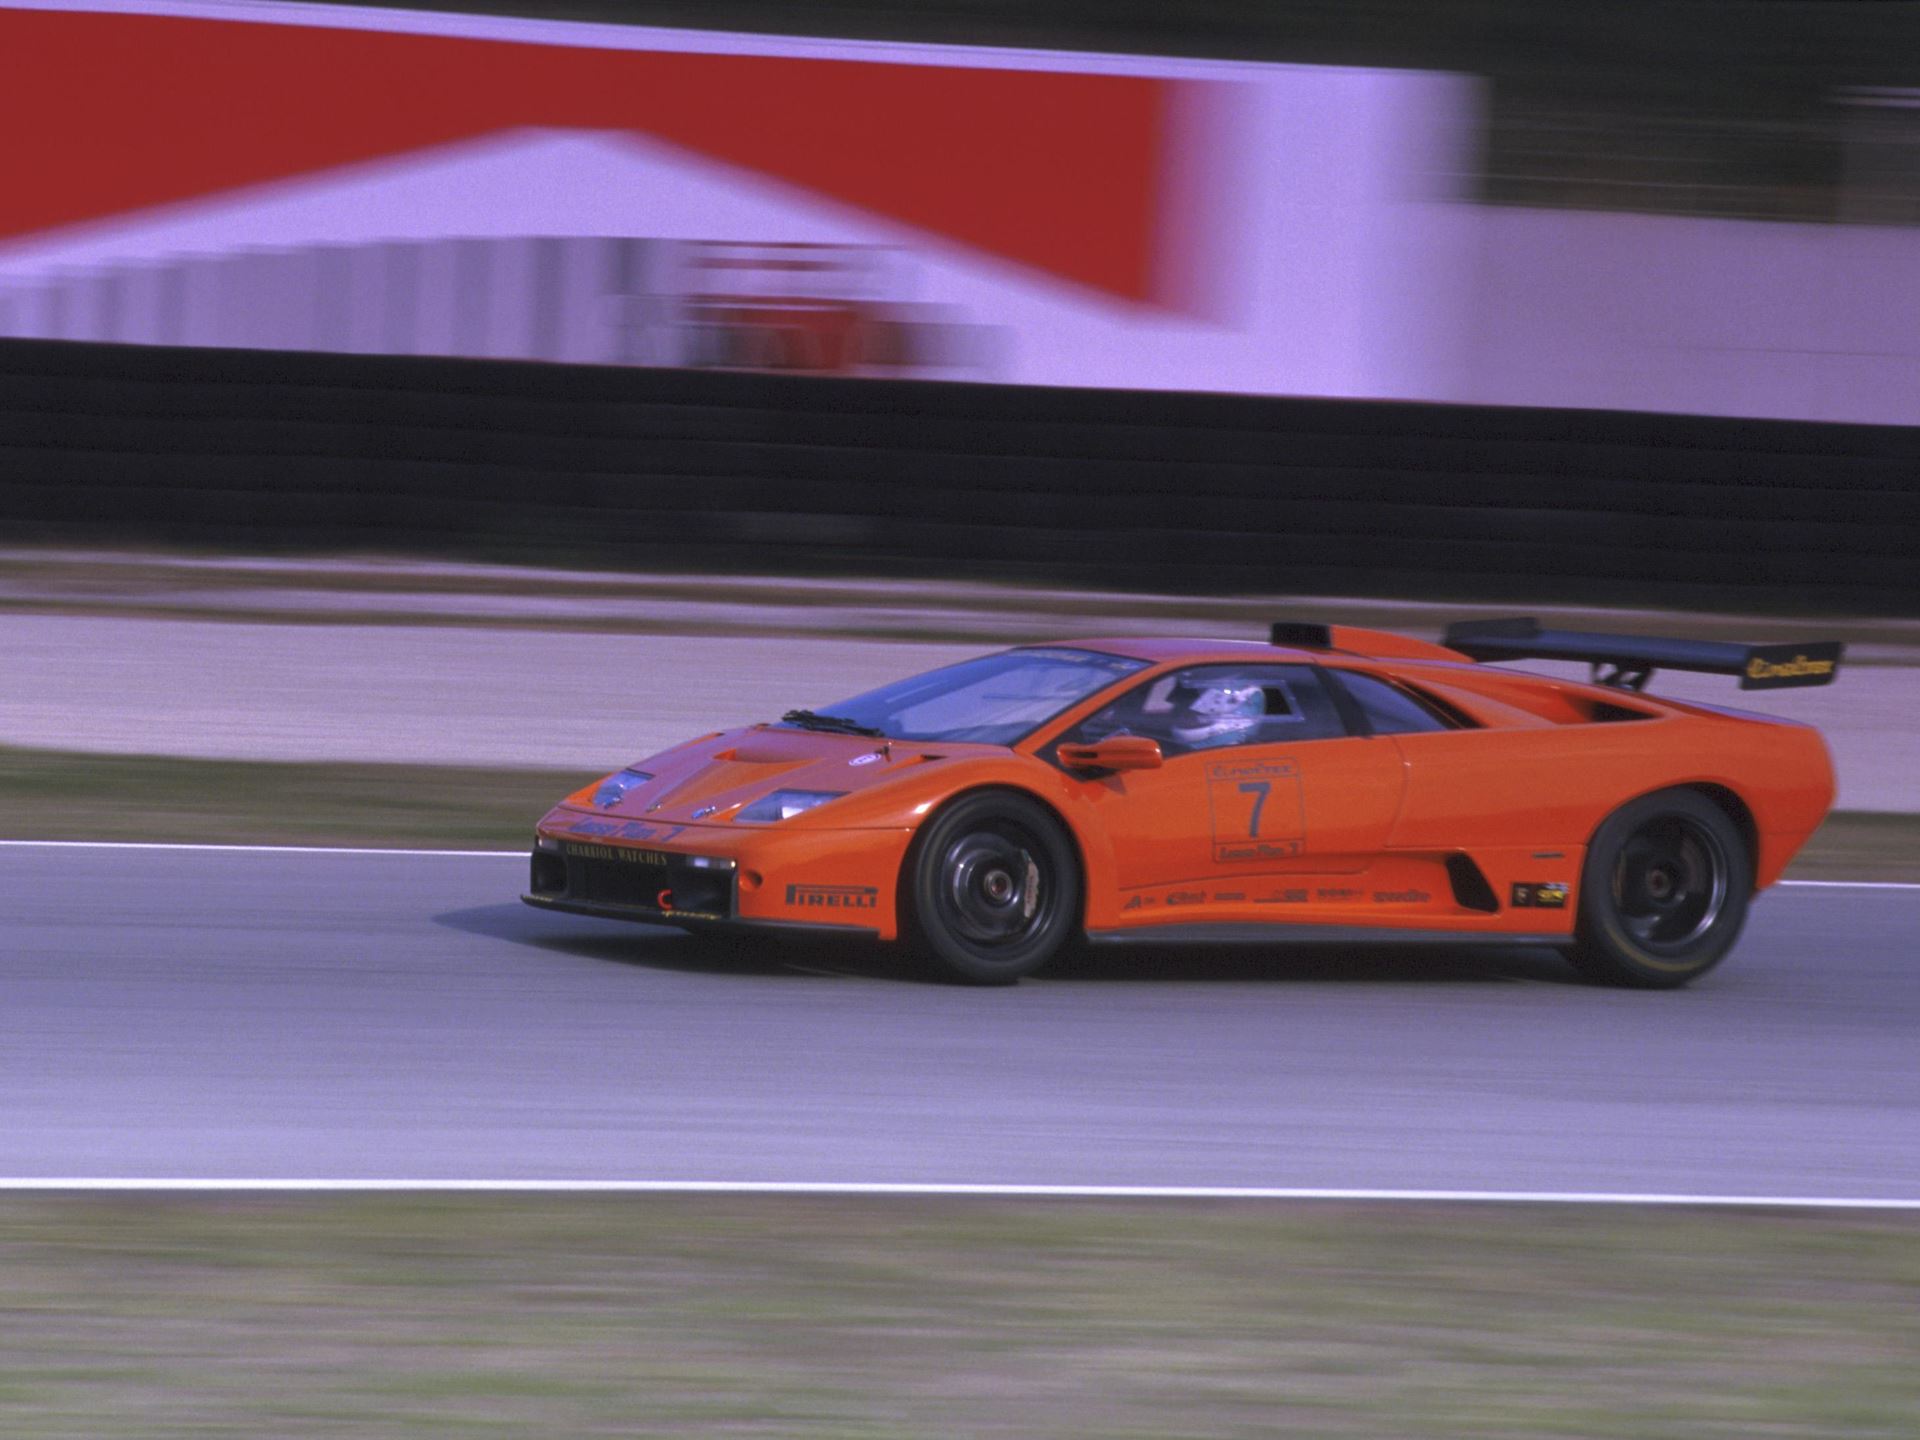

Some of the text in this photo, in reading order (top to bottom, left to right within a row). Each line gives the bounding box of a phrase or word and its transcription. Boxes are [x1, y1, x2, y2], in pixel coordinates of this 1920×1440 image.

[1239, 781, 1271, 838] 7
[618, 847, 668, 866] WATCHES
[785, 883, 880, 908] PIRELLI
